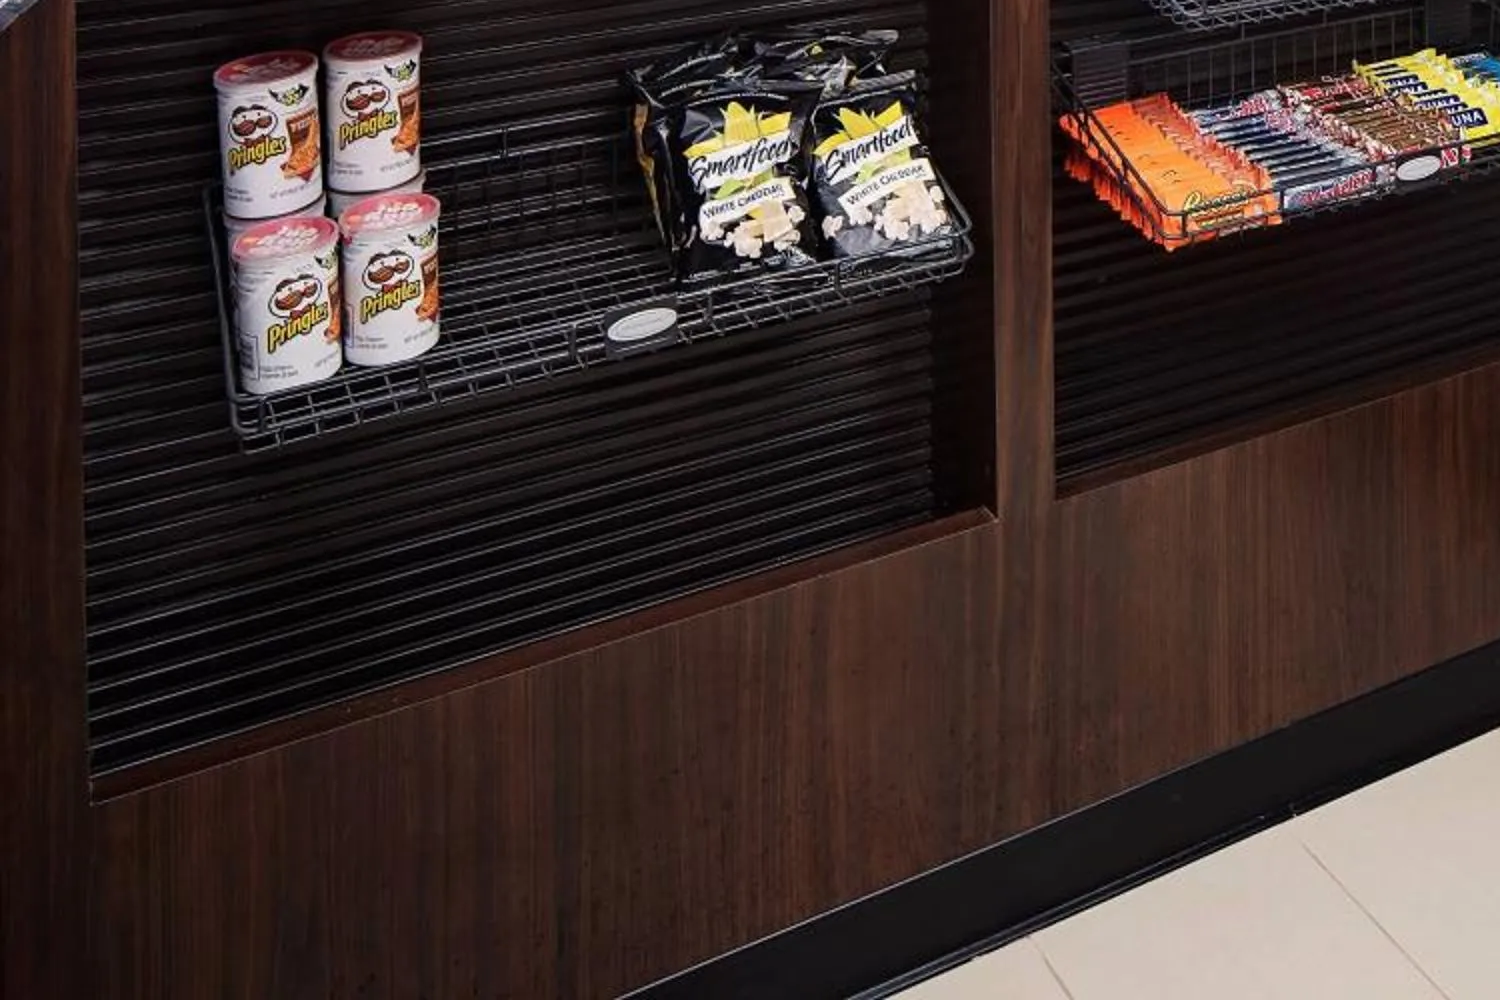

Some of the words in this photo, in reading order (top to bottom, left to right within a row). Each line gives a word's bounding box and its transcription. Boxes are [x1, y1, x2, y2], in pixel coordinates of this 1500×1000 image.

[338, 109, 398, 150] Pringles
[824, 122, 913, 181] Smartfood
[228, 136, 288, 175] Pringles
[689, 133, 794, 184] Smartfood
[359, 279, 422, 324] Pringles
[267, 302, 329, 354] Pringles
